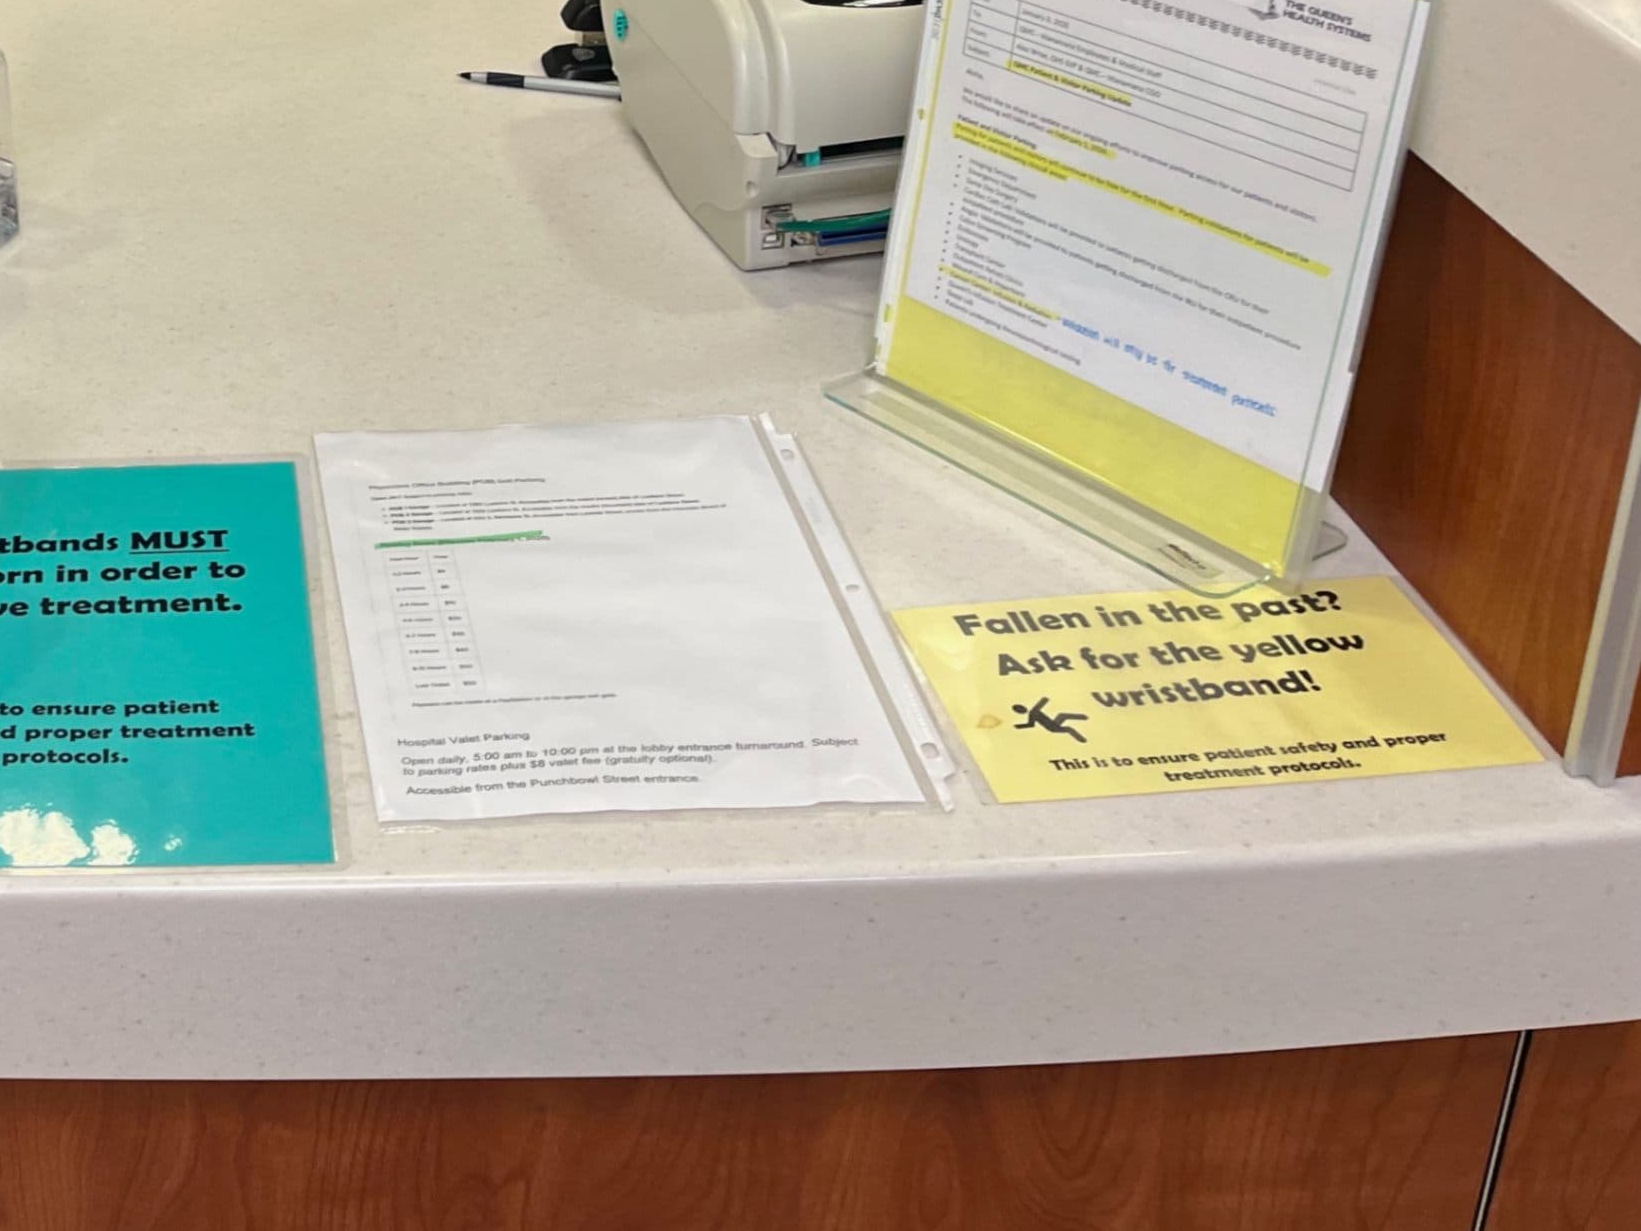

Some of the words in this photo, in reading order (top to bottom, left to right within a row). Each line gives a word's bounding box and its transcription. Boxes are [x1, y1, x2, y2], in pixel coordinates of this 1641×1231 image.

[1282, 10, 1323, 29] HEALTH
[1325, 20, 1372, 44] SYSTEMS
[129, 529, 229, 552] MUST
[56, 564, 90, 584] in
[100, 560, 197, 582] order
[208, 561, 246, 580] to
[40, 592, 243, 616] treatment.
[952, 606, 1090, 638] Fallen
[1101, 604, 1141, 630] in
[1148, 597, 1222, 625] the
[1235, 590, 1343, 623] past?
[997, 649, 1075, 677] Ask
[1081, 644, 1139, 672] for
[1150, 638, 1222, 665] the
[1230, 629, 1366, 662] yellow
[1090, 669, 1322, 709] wristband!
[31, 702, 115, 717] ensure
[123, 699, 220, 719] patient
[24, 725, 112, 744] proper
[121, 722, 255, 740] treatment
[397, 736, 446, 748] Hospital
[449, 734, 480, 745] Valet
[483, 731, 530, 742] Parking
[1, 748, 129, 767] protocols.
[401, 756, 434, 767] Open
[503, 751, 522, 759] am
[526, 750, 538, 758] to
[579, 746, 599, 756] pm
[603, 745, 615, 753] at
[617, 744, 637, 753] the
[640, 742, 675, 754] lobby
[677, 742, 732, 752] entrance
[811, 737, 859, 748] Subject
[1049, 755, 1090, 773] This
[1092, 755, 1109, 769] is
[1112, 755, 1134, 769] to
[1137, 750, 1200, 767] ensure
[1203, 744, 1275, 764] patient
[1278, 738, 1338, 759] safety
[1343, 734, 1379, 751] and
[1383, 729, 1448, 751] proper
[403, 766, 415, 776] to
[418, 765, 462, 777] parking
[466, 763, 497, 773] rates
[500, 761, 526, 772] plus
[549, 757, 579, 768] valet
[582, 756, 601, 765] fee
[605, 754, 656, 766] (gratuity
[1165, 766, 1265, 784] treatment
[1268, 759, 1363, 779] protocols.
[406, 785, 472, 796] Accessible
[475, 782, 504, 792] from
[507, 779, 527, 789] the
[530, 776, 599, 787] Punchbowl
[602, 774, 640, 784] Street
[643, 773, 702, 783] entrance.
